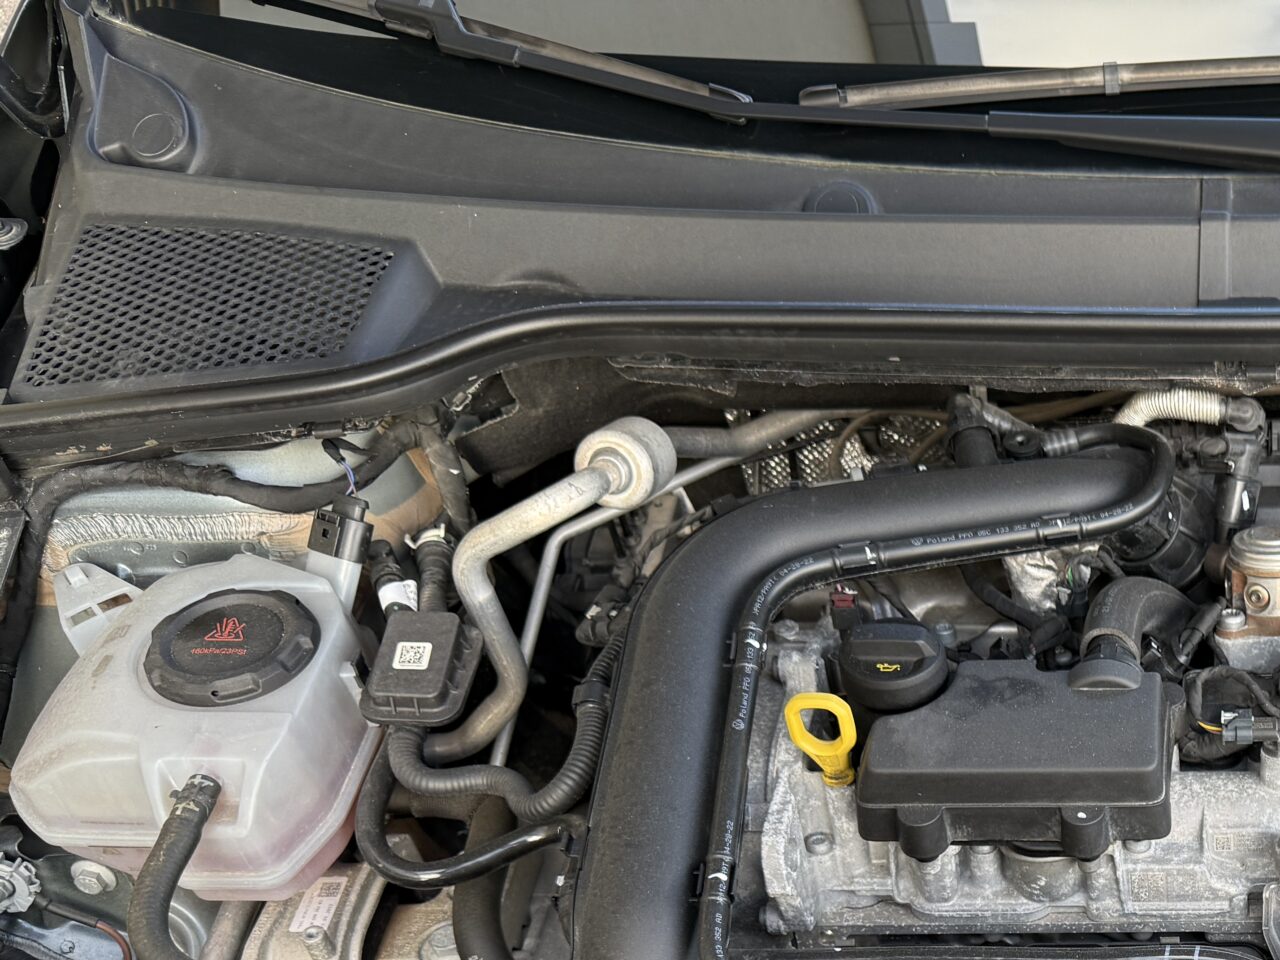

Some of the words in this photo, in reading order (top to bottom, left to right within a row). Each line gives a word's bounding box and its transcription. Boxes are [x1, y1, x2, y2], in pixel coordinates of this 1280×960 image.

[926, 535, 956, 545] Poland
[996, 526, 1010, 534] 133
[739, 692, 750, 718] Poland
[714, 928, 722, 944] 352
